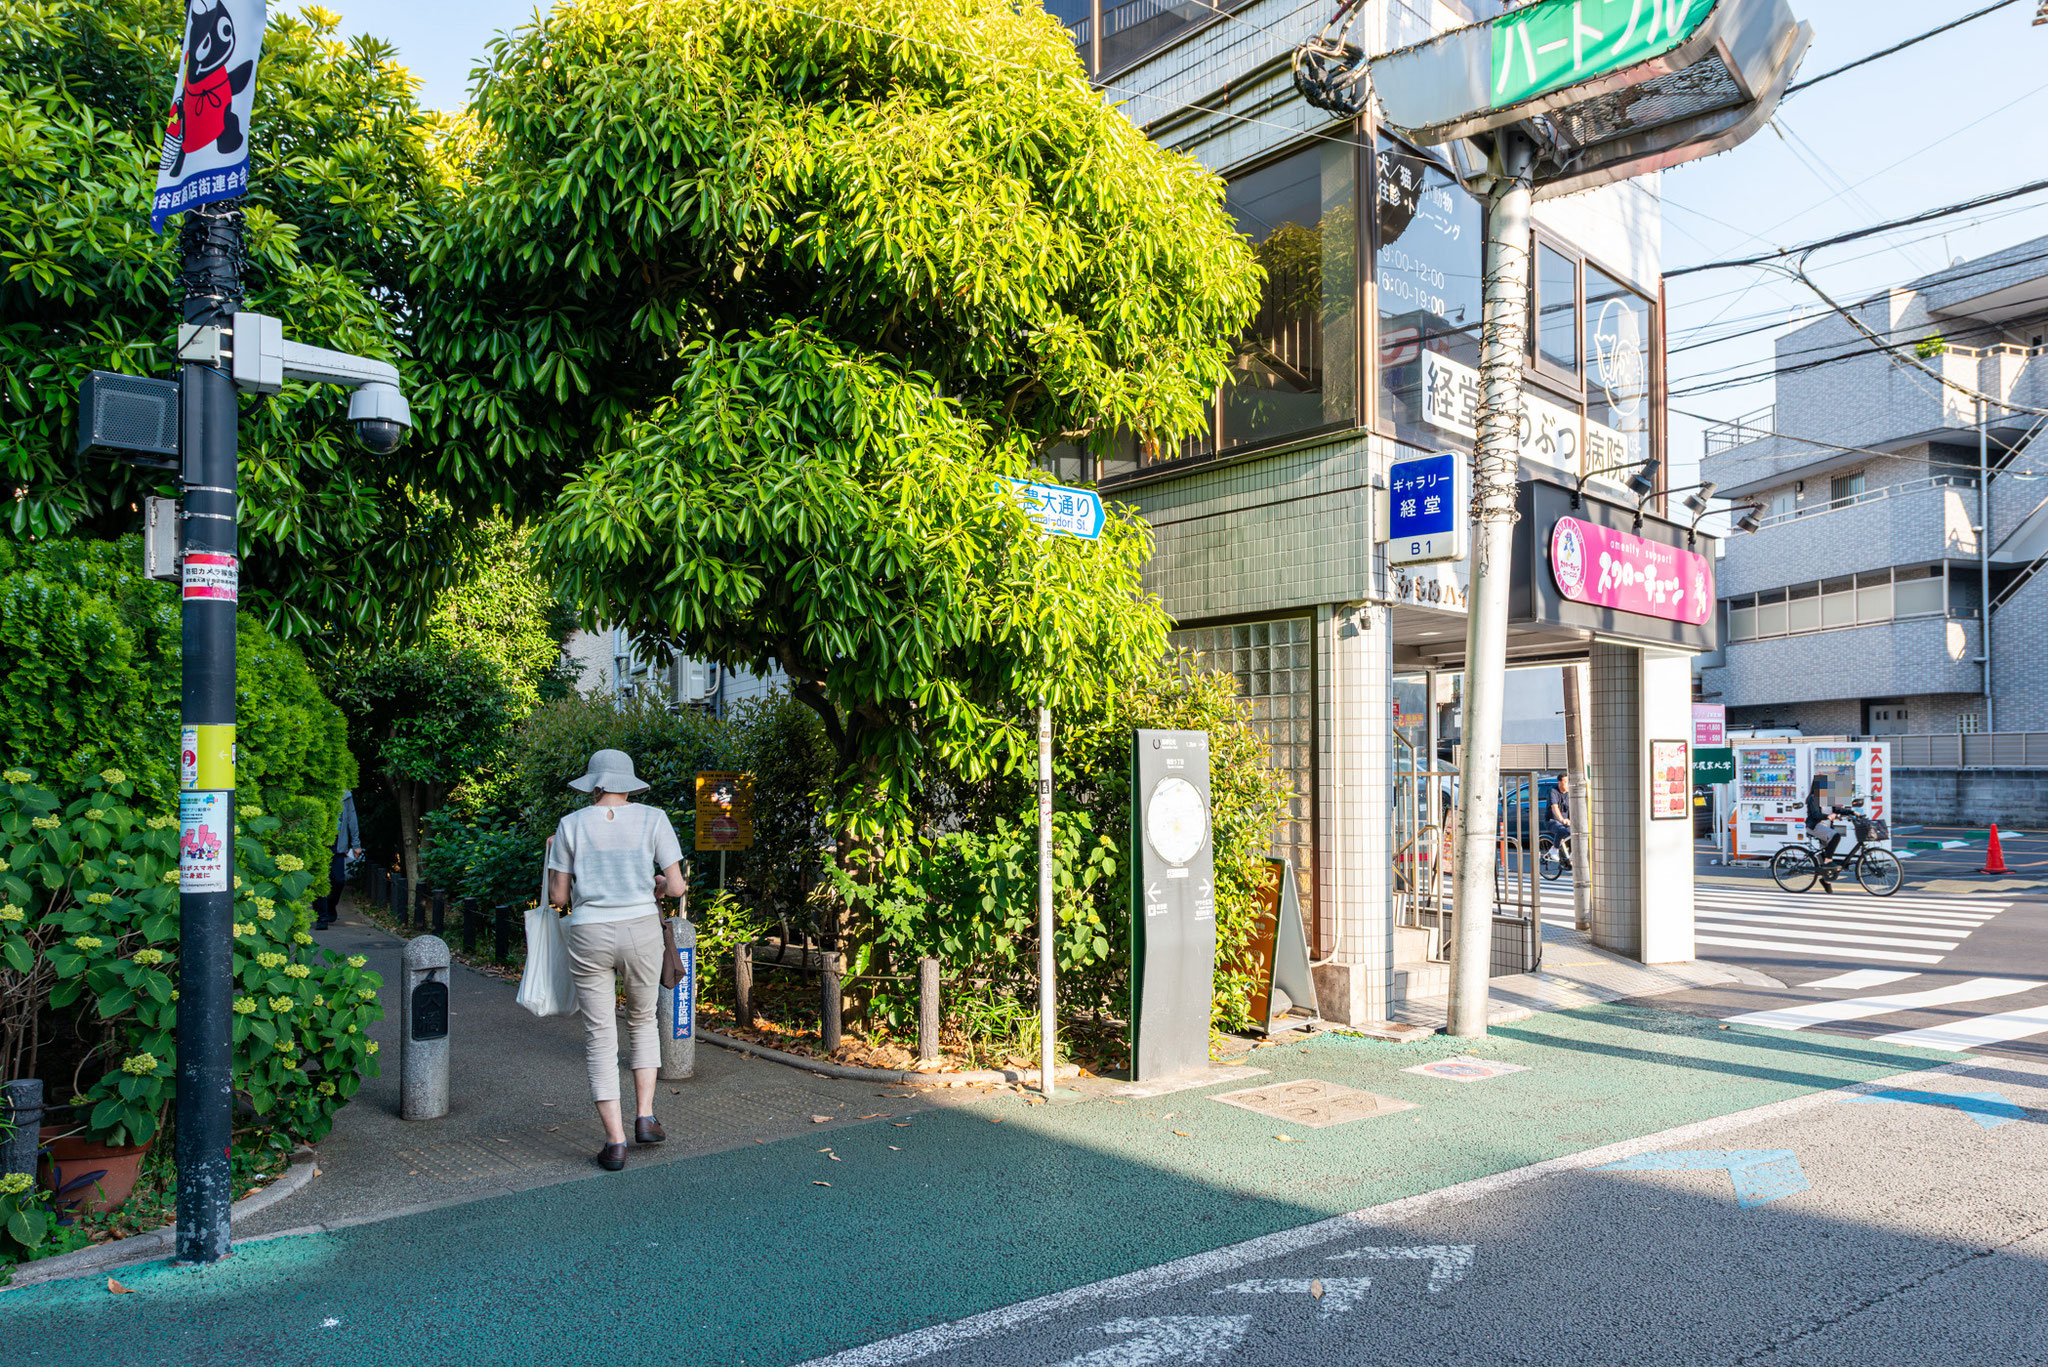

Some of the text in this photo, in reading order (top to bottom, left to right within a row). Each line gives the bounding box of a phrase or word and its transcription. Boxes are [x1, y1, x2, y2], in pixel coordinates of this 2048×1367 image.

[1393, 473, 1450, 493] ギャラリー
